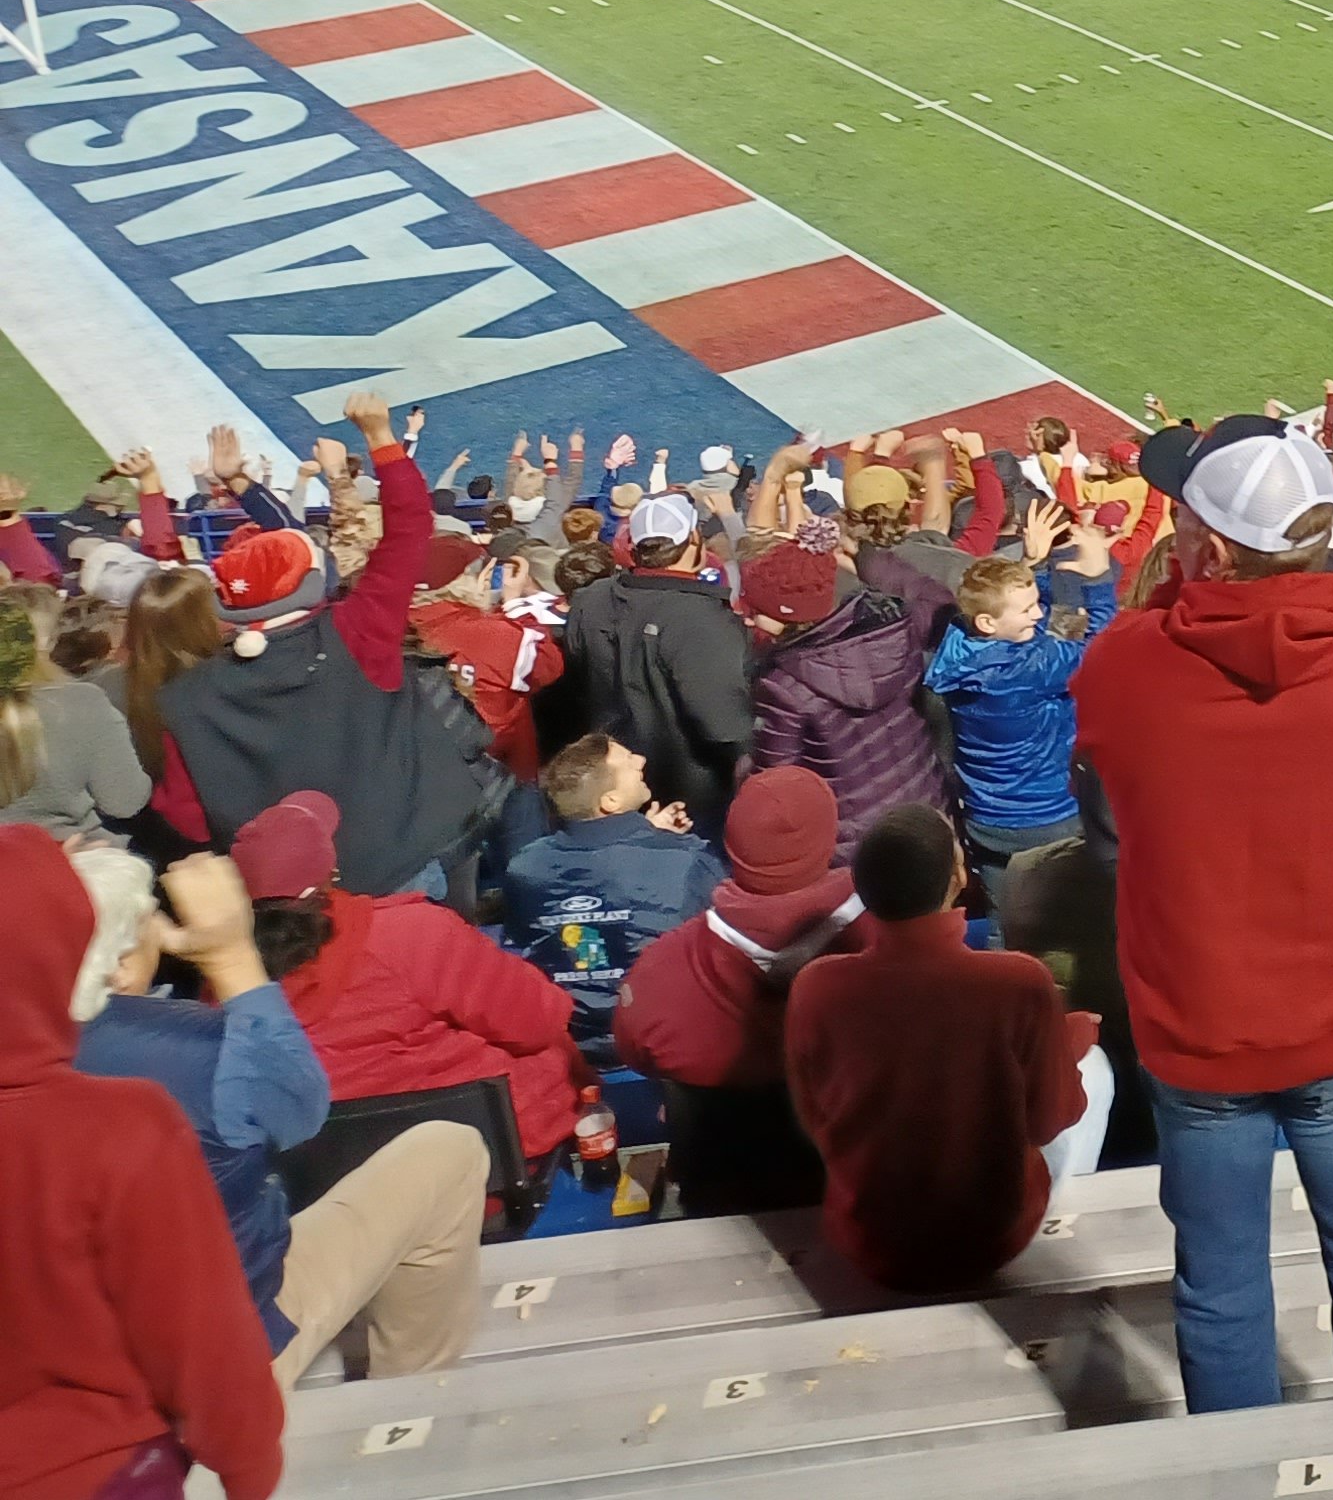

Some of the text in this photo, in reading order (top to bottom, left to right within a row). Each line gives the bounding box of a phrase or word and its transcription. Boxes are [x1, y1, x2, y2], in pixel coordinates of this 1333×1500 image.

[512, 1281, 538, 1301] 4
[725, 1379, 750, 1400] 3
[384, 1424, 413, 1446] 4
[1303, 1463, 1322, 1487] 1
